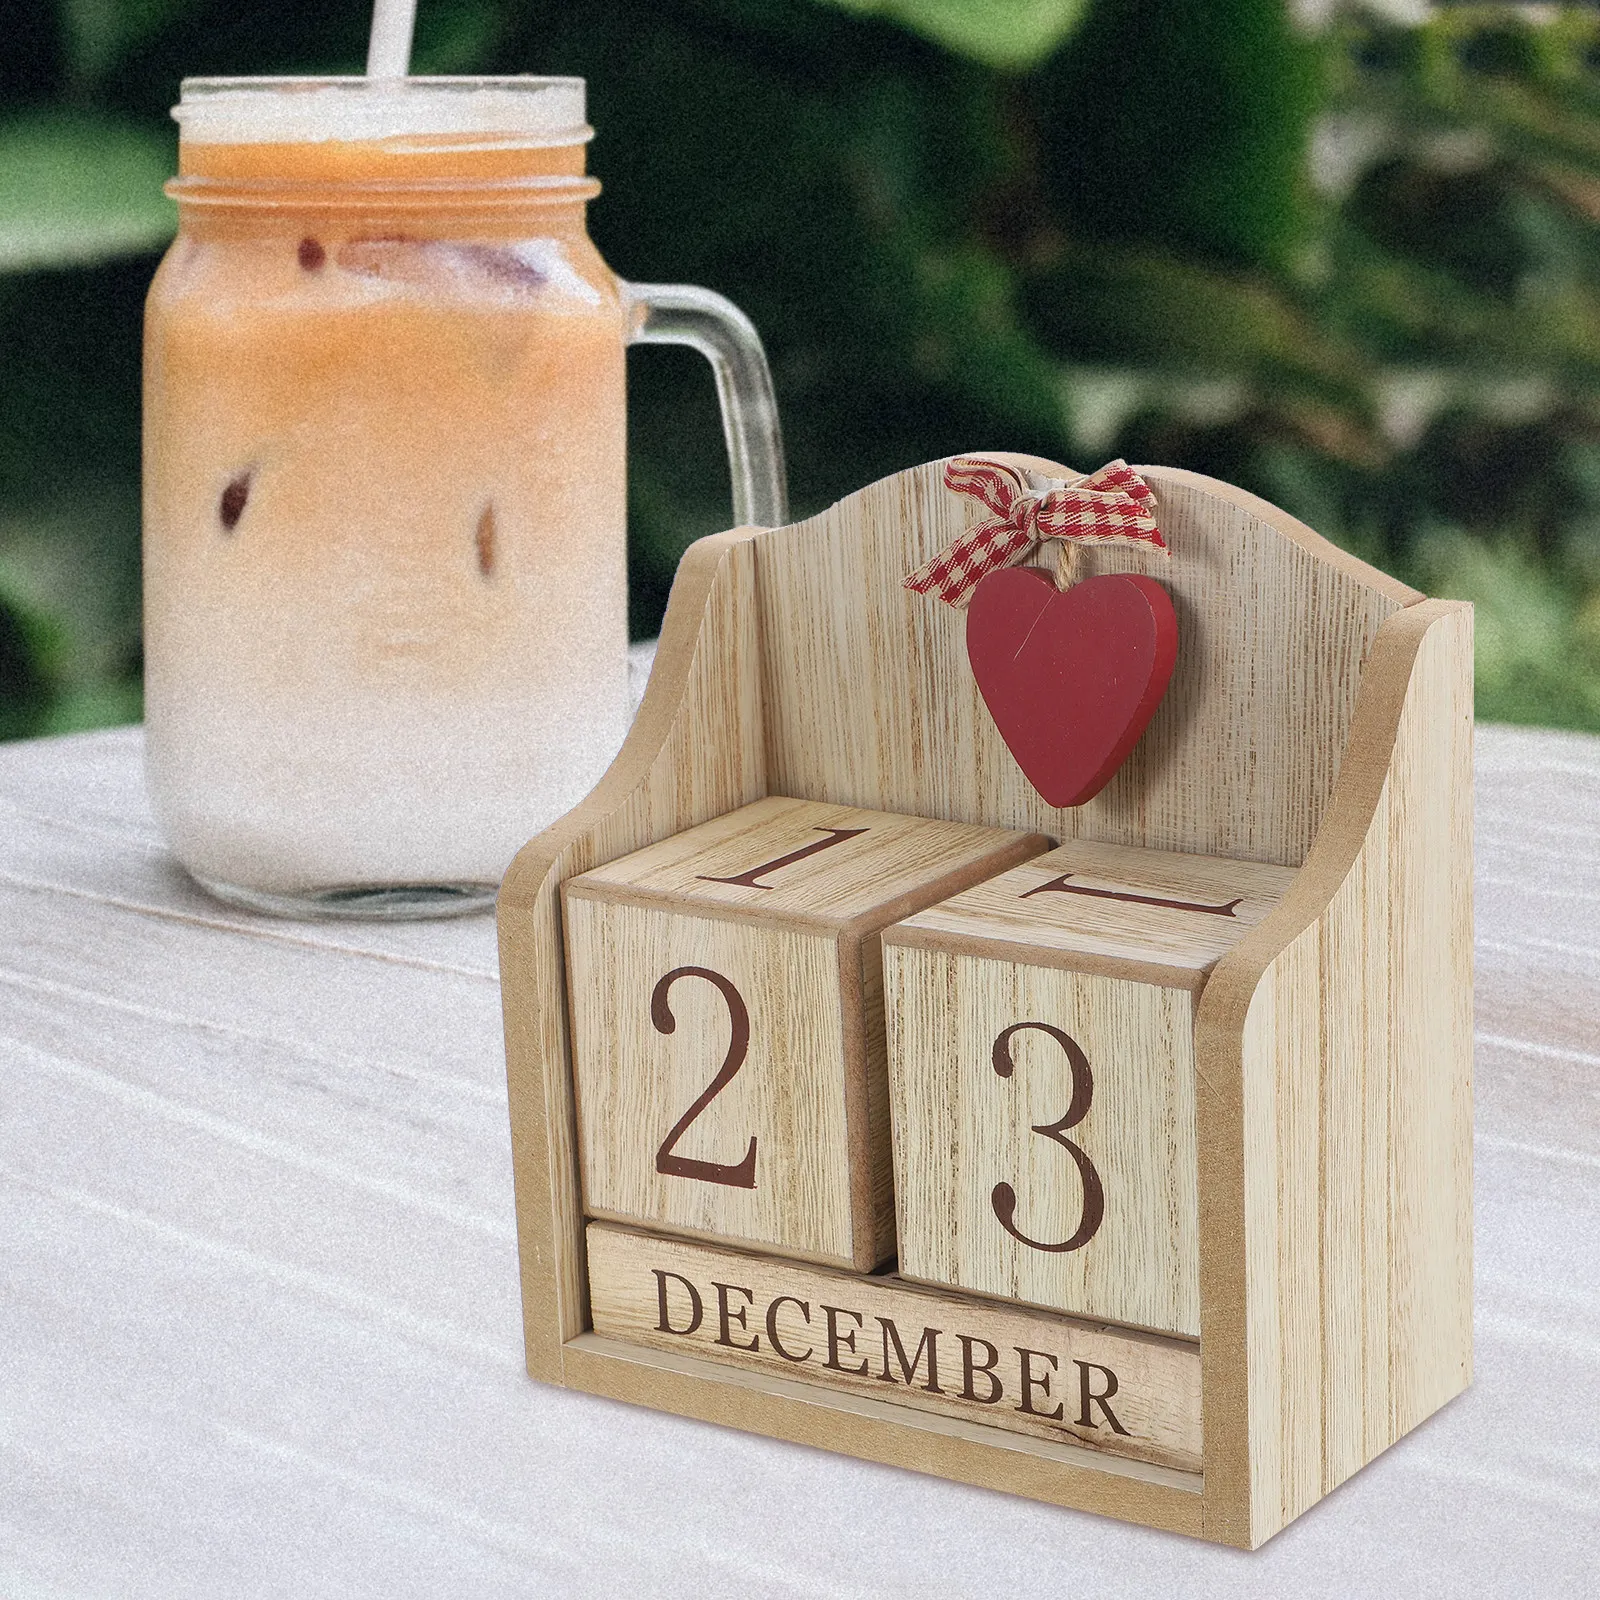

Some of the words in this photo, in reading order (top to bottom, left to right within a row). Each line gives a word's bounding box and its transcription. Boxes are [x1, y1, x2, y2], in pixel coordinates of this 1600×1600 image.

[697, 827, 872, 890] 1
[1019, 873, 1244, 918] 1
[650, 965, 758, 1190] 2
[991, 1022, 1106, 1253] 3
[651, 1269, 1132, 1437] DECEMBER
